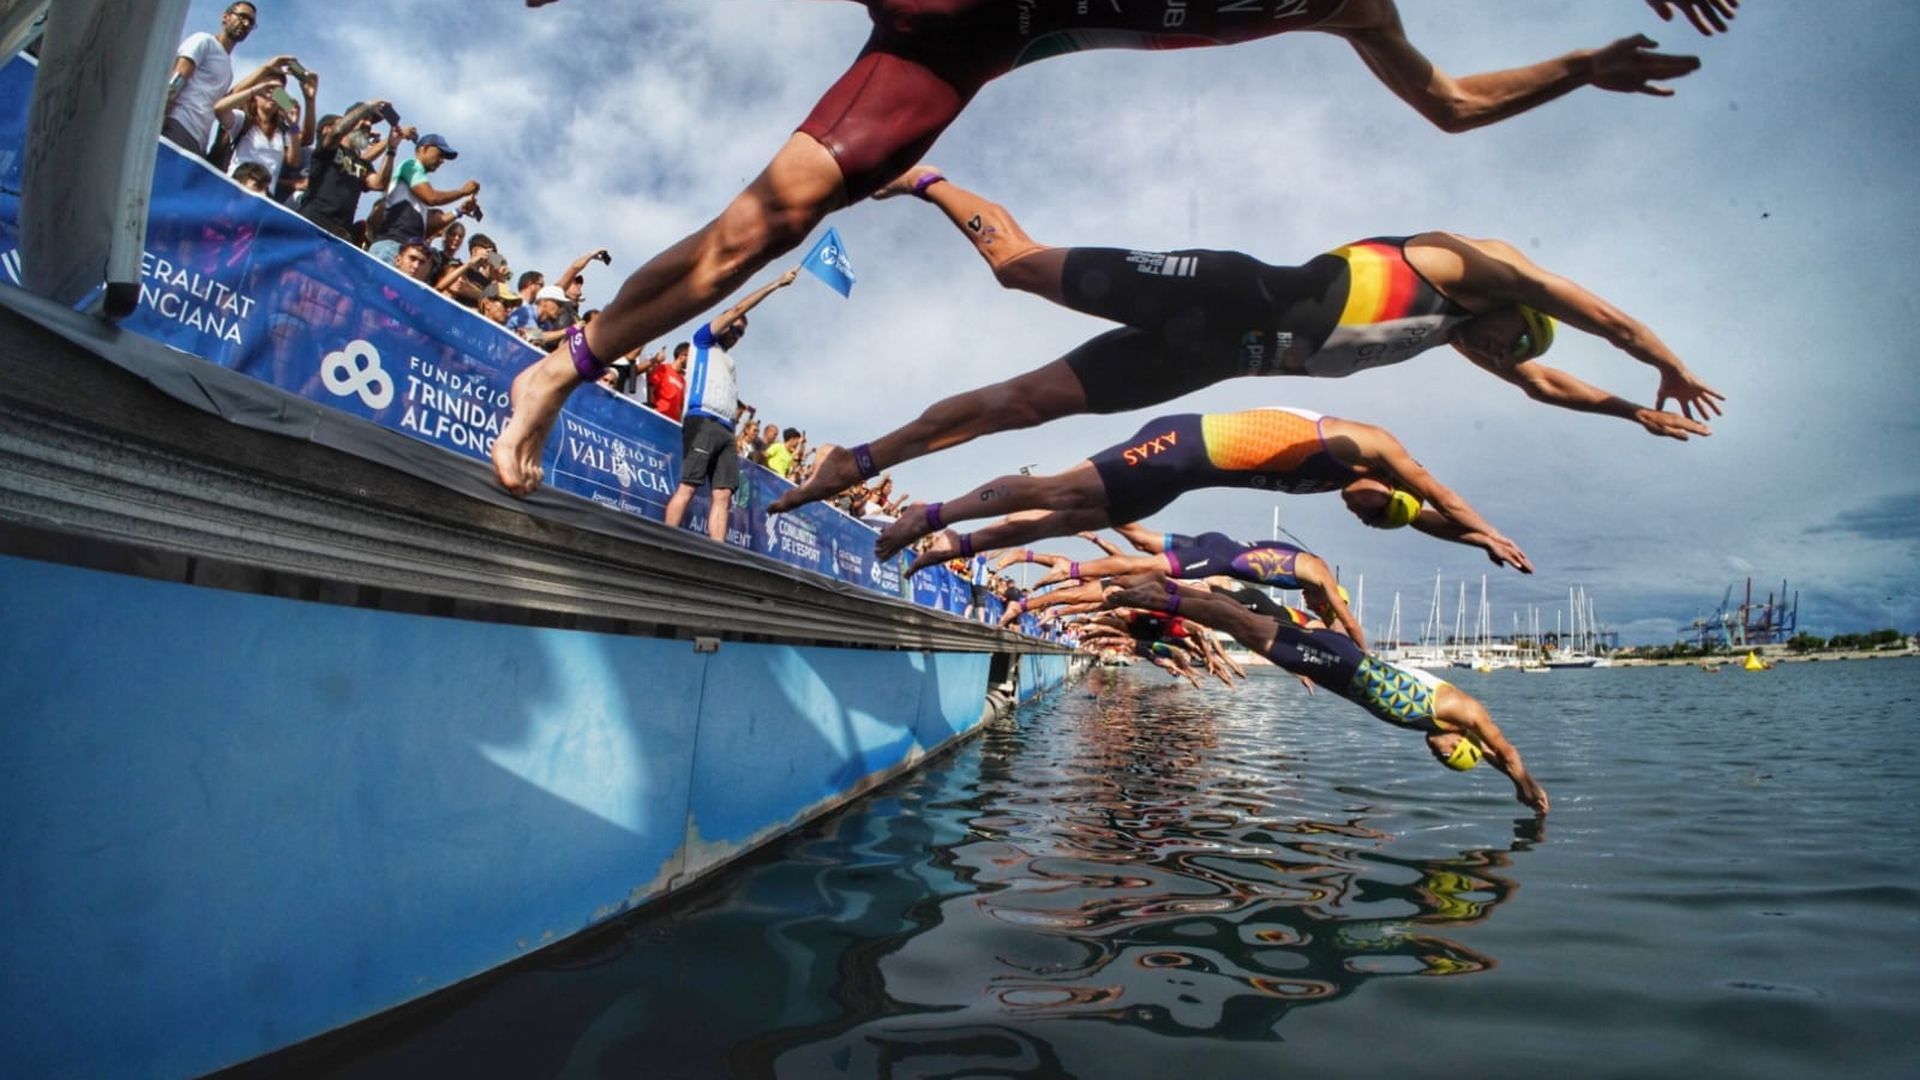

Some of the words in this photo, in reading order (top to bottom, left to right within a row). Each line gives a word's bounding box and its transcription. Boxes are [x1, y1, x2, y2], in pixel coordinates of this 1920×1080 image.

[141, 251, 255, 318] ERALITAT
[138, 282, 242, 345] NCIANA
[410, 355, 514, 411] FUNDACIÓ
[566, 419, 645, 463] DIPUTIÓ
[648, 455, 665, 472] DE
[1122, 430, 1177, 466] AXAS
